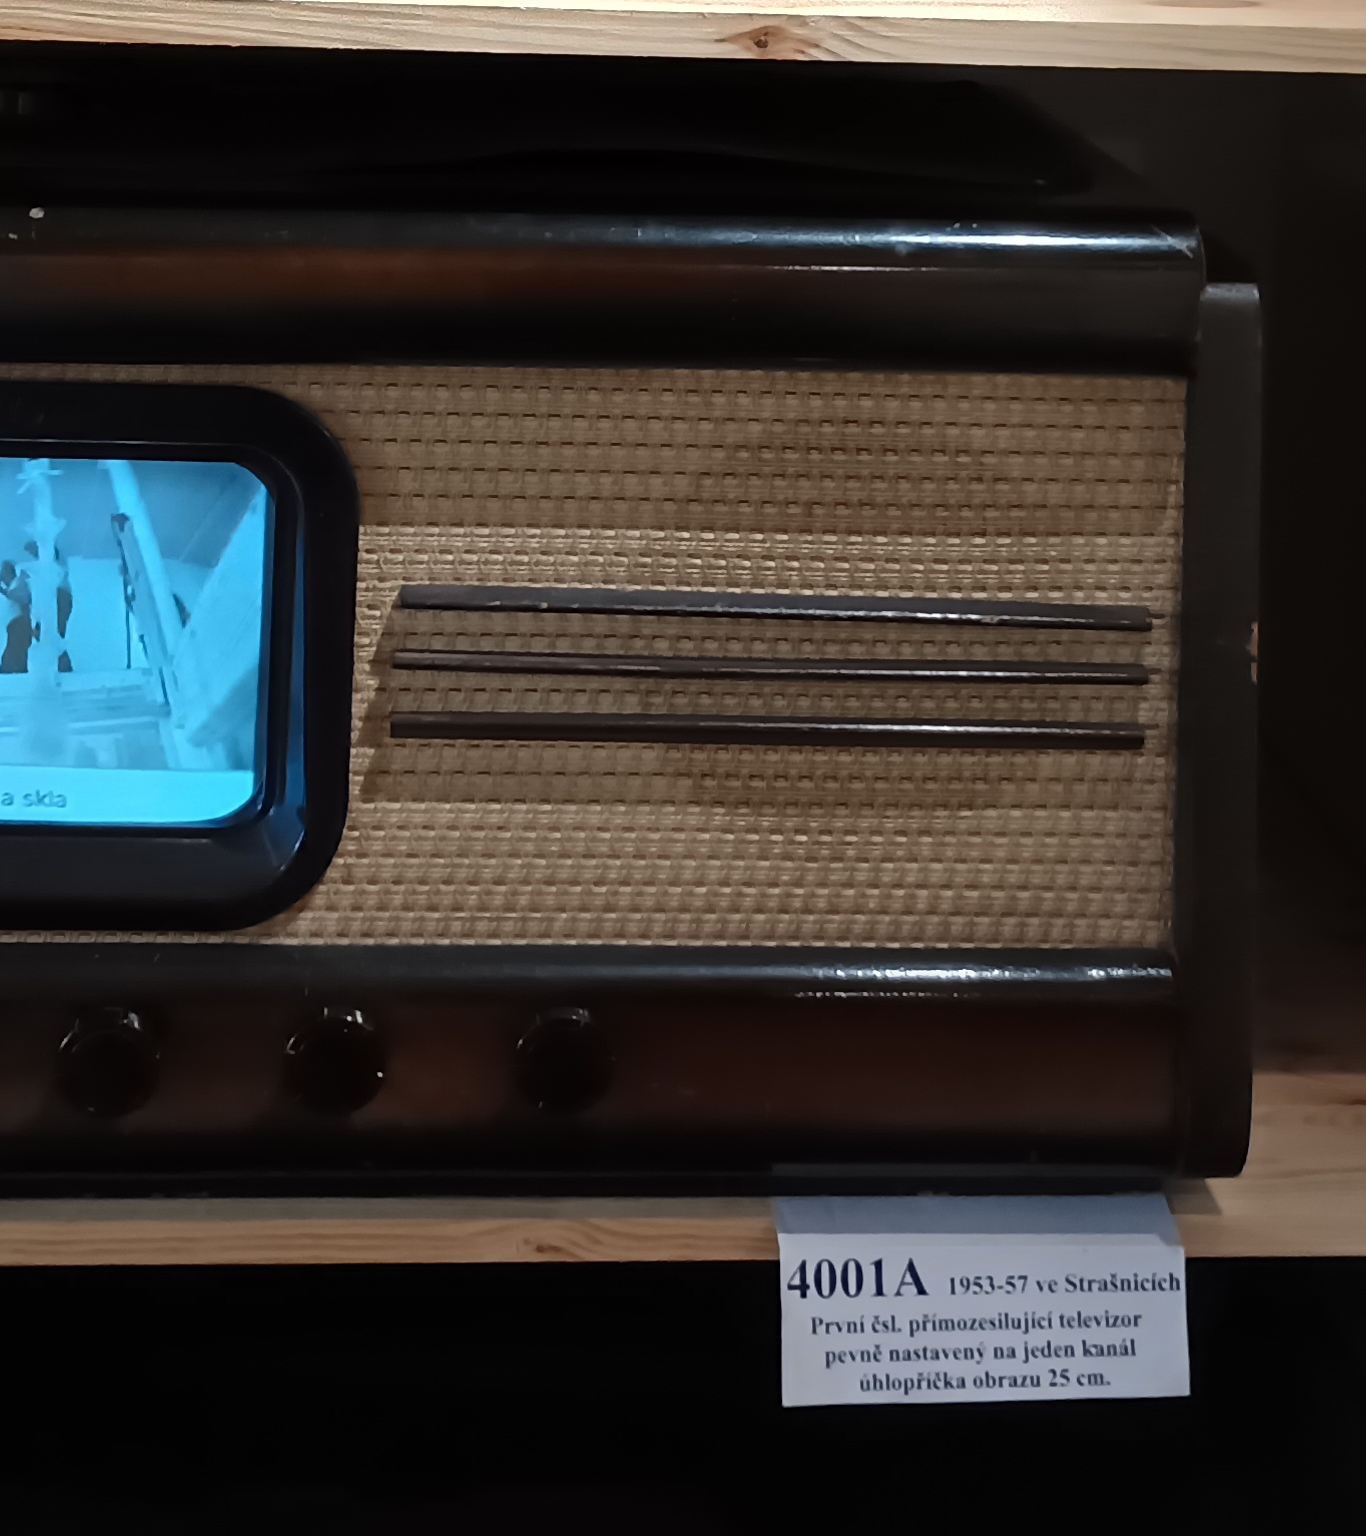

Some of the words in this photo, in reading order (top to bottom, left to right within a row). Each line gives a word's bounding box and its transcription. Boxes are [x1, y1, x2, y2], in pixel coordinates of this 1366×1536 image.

[0, 792, 15, 807] a
[22, 788, 69, 809] skla
[787, 1257, 929, 1299] 4001A
[949, 1275, 1028, 1296] 1953-57
[1036, 1279, 1058, 1294] ve
[1065, 1272, 1180, 1293] Strašnicích
[811, 1315, 865, 1335] První
[871, 1314, 902, 1334] čsl.
[909, 1311, 1053, 1338] přímozesilující
[1058, 1309, 1143, 1329] televizor
[825, 1344, 882, 1369] pevně
[889, 1342, 985, 1365] nastavený
[993, 1346, 1017, 1360] na
[1022, 1340, 1075, 1364] jeden
[1081, 1338, 1136, 1357] kanál
[859, 1371, 966, 1395] úhlopříčka
[972, 1370, 1041, 1389] obrazu
[1048, 1368, 1071, 1387] 25
[1076, 1373, 1111, 1387] cm.
